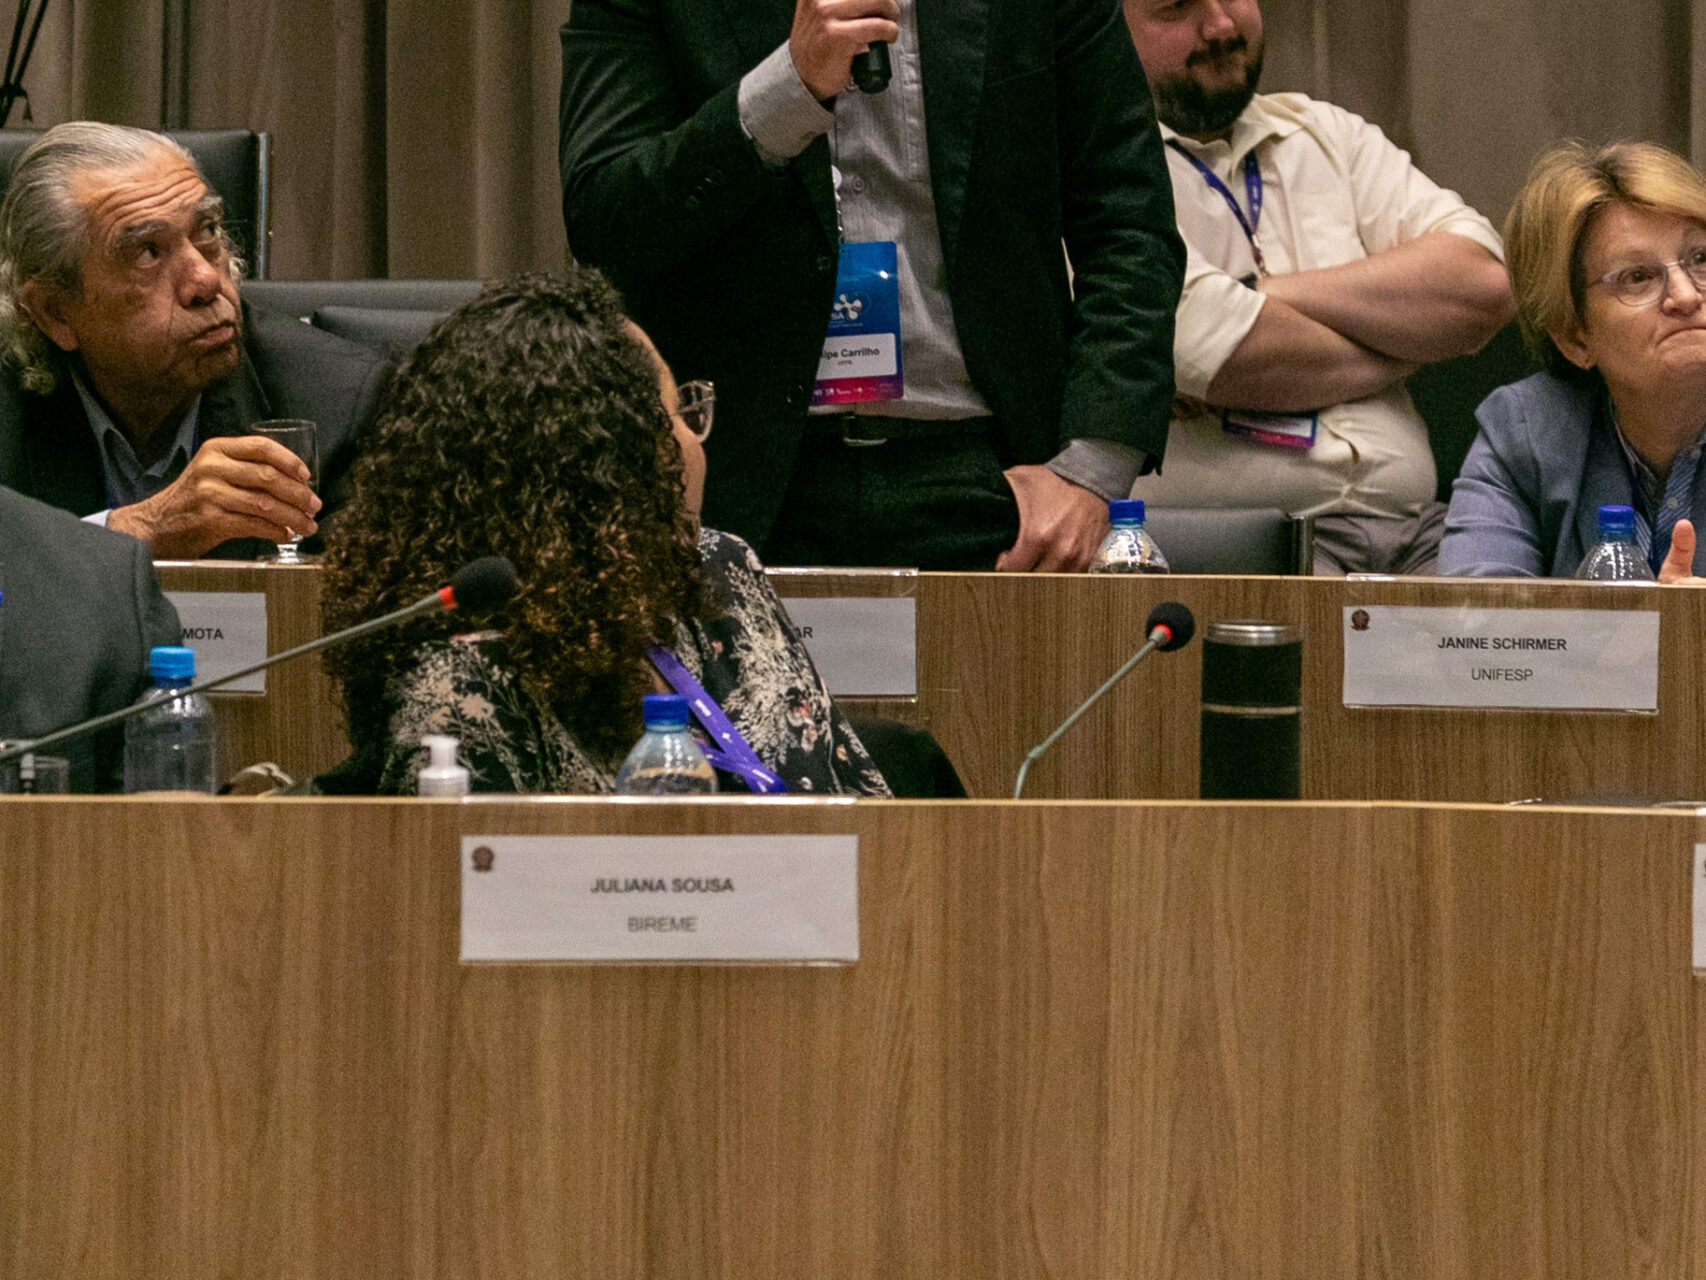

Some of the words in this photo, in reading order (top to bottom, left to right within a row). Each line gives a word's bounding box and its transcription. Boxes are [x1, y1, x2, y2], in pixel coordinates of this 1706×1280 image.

[841, 348, 880, 358] Carrilho
[182, 628, 224, 640] MOTA
[1438, 637, 1489, 650] JANINE
[1492, 637, 1567, 651] SCHIRMER
[1471, 668, 1534, 681] UNIFESP
[590, 877, 666, 894] JULIANA
[671, 877, 735, 893] SOUSA
[627, 916, 698, 933] BIREME
